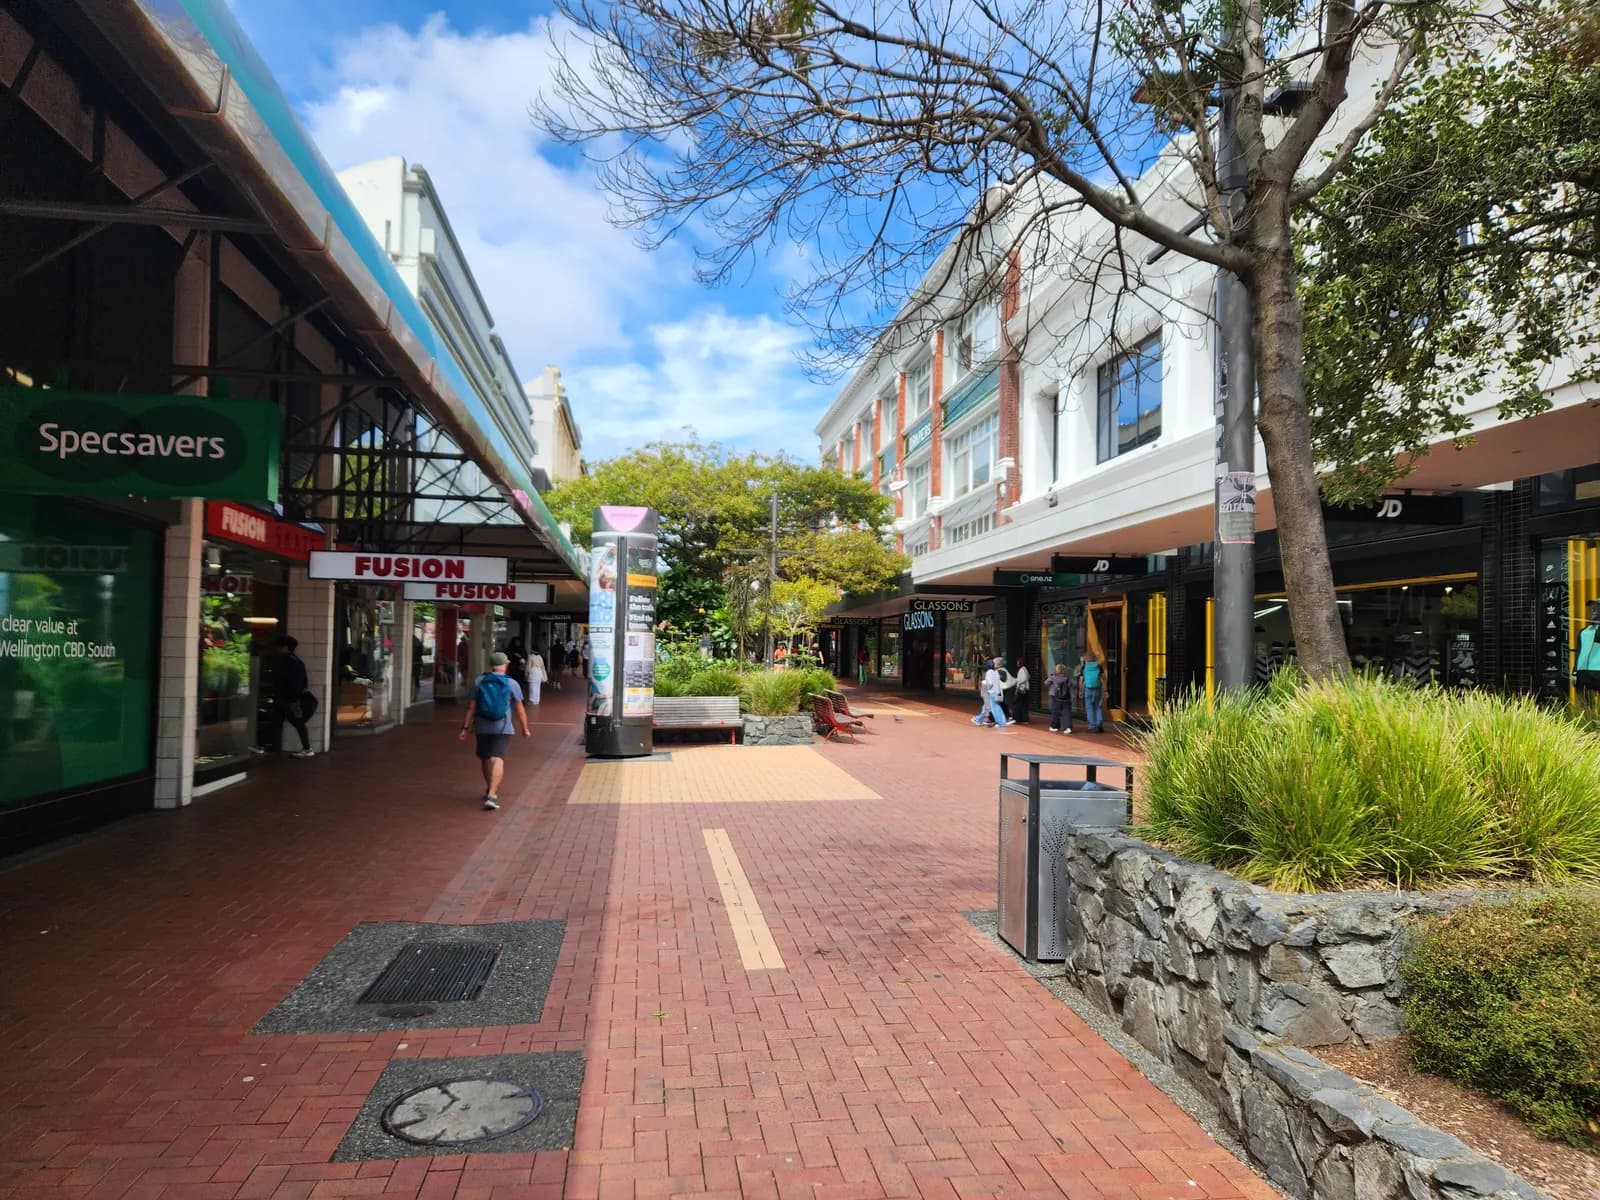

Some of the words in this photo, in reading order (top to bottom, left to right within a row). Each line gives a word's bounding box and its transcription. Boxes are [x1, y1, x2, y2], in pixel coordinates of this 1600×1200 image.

[39, 422, 225, 459] Specsavers
[1377, 498, 1403, 518] JD
[221, 506, 267, 542] FUSION
[354, 556, 465, 579] FUSION
[1092, 560, 1110, 572] JD
[1029, 575, 1053, 583] one.nz
[435, 583, 517, 600] FUSION
[914, 600, 970, 611] GLASSONS
[1, 614, 32, 633] clear
[35, 617, 65, 635] value
[66, 619, 78, 635] at
[903, 610, 934, 630] GLASSONS
[0, 640, 60, 661] Wellington
[63, 642, 86, 658] CBD
[87, 642, 116, 658] South
